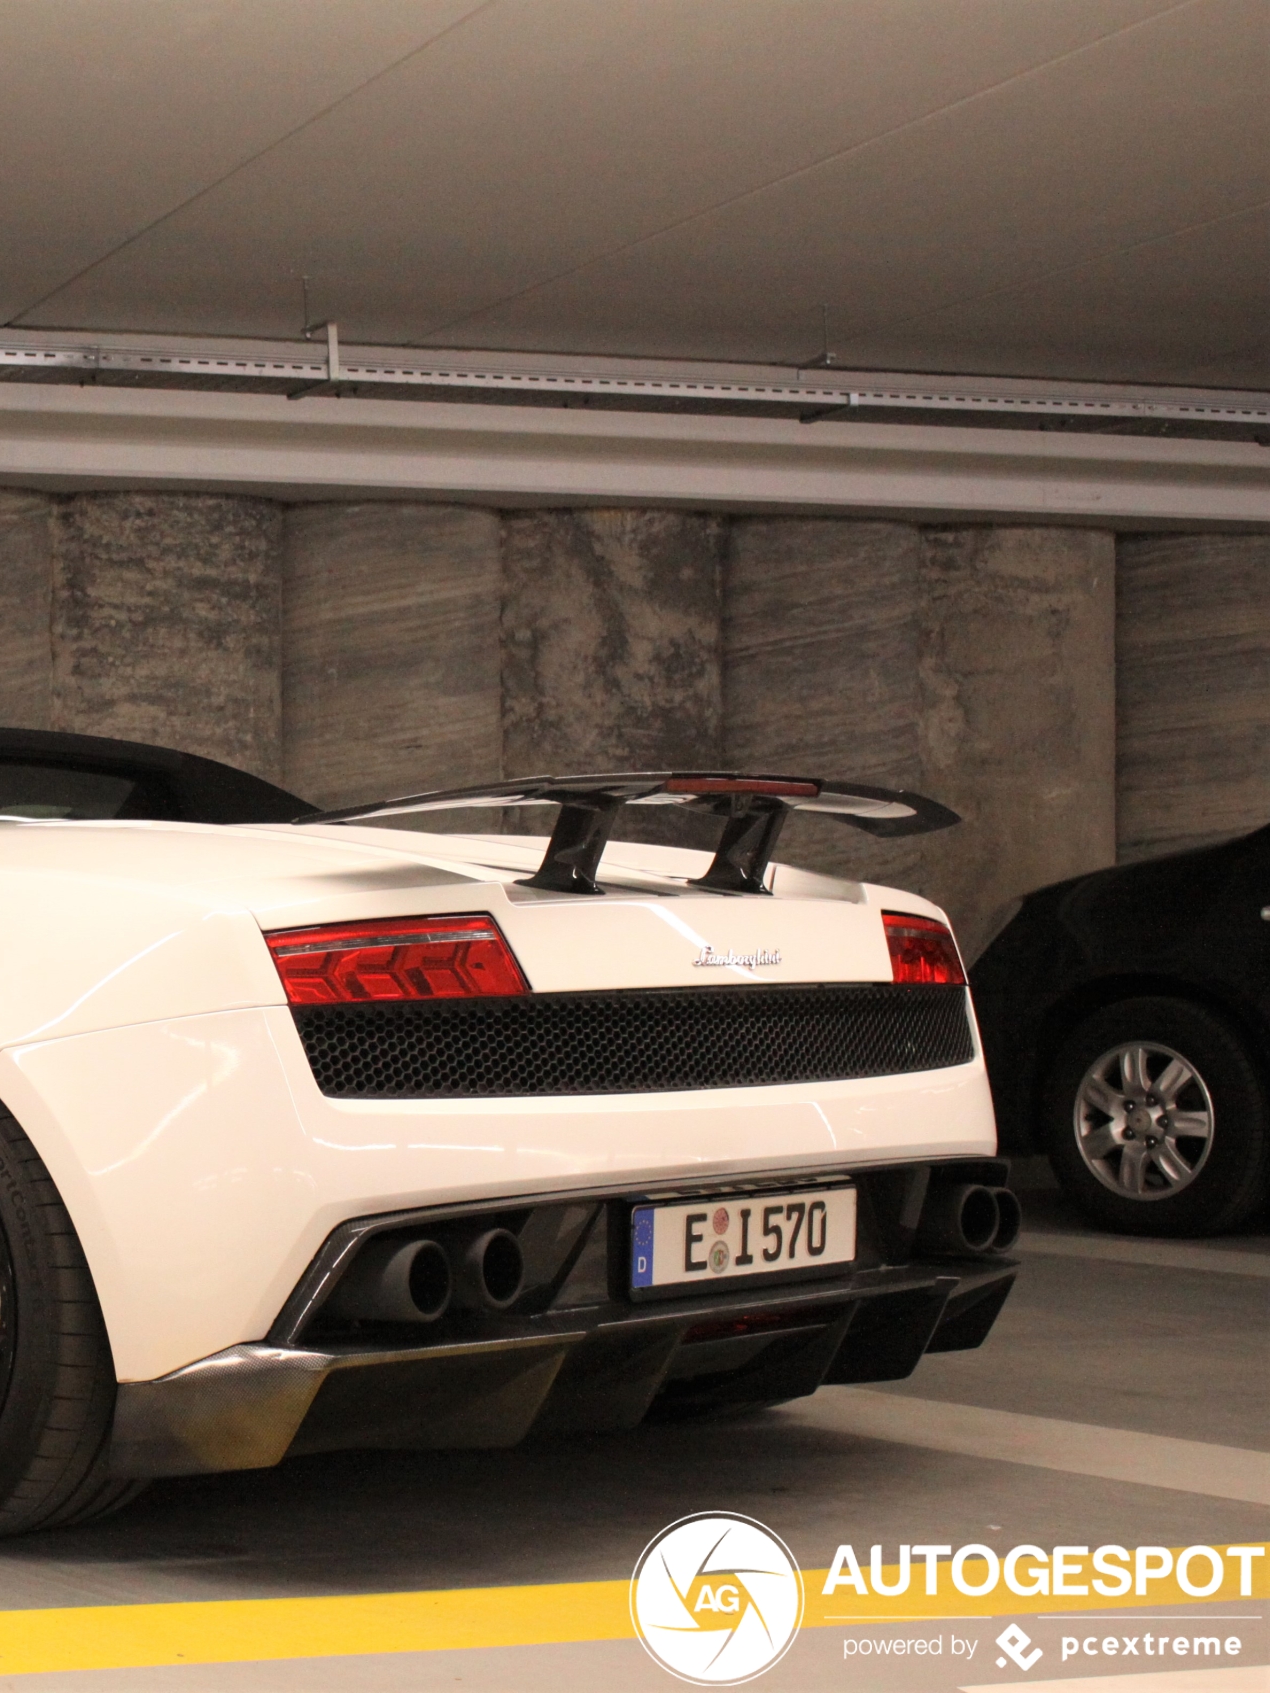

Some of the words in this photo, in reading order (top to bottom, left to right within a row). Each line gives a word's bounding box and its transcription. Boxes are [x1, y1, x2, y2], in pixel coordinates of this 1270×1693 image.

[692, 945, 781, 971] Lamborghini
[685, 1213, 707, 1272] E
[637, 1256, 647, 1273] D
